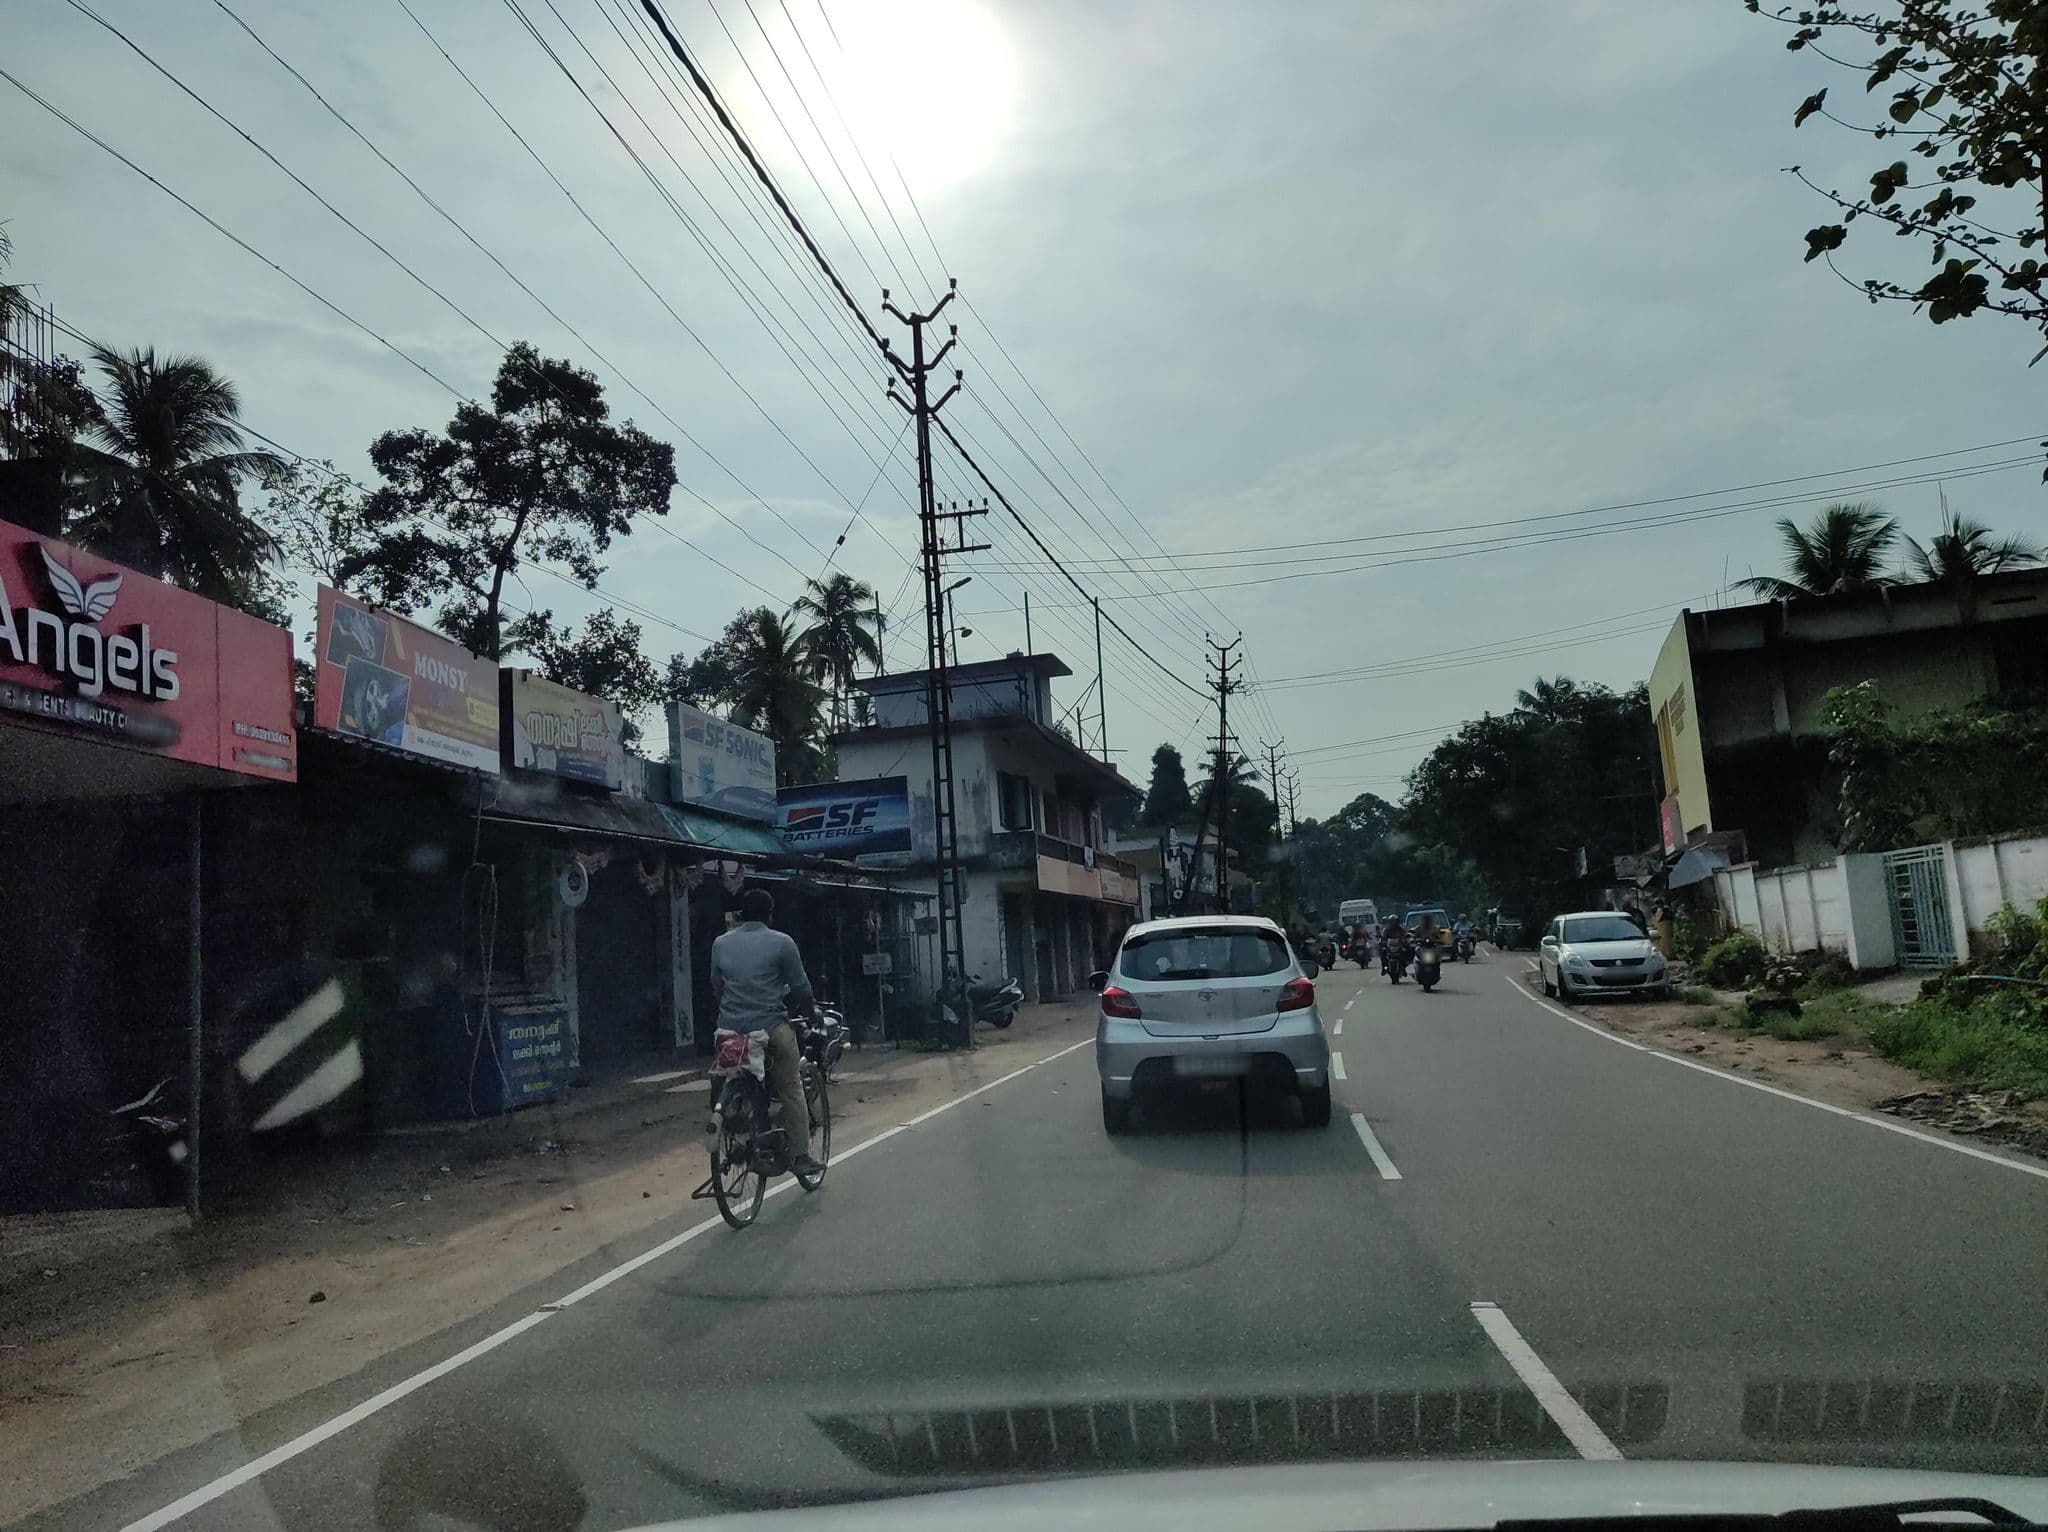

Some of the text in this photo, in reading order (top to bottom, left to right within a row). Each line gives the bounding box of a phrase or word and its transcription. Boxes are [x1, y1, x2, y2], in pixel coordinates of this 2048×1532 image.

[413, 651, 468, 693] MONSY
[705, 722, 772, 768] SF SONIC
[826, 801, 880, 828] SF
[784, 825, 874, 843] BATTERIES
